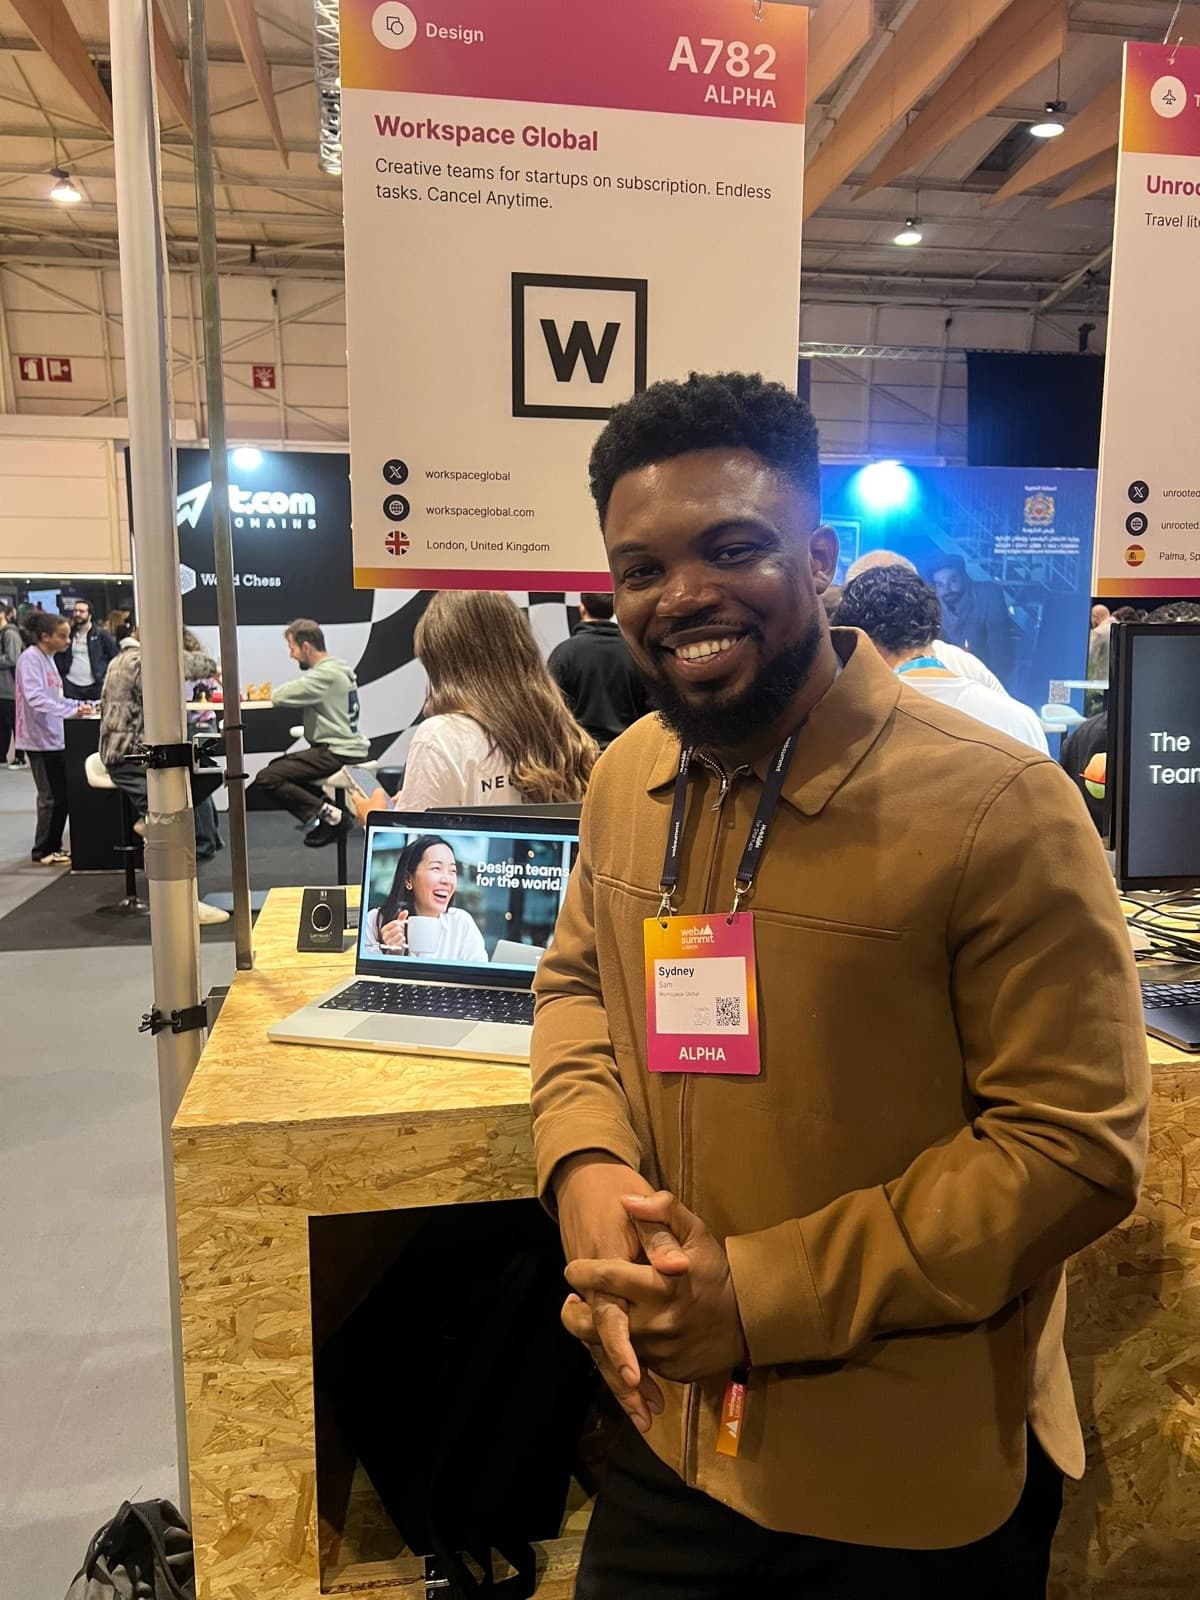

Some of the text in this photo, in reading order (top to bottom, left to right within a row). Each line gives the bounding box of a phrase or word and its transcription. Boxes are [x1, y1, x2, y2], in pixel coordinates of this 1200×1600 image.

[425, 22, 485, 43] Design
[668, 36, 777, 81] A782
[703, 84, 777, 109] ALPHA
[374, 114, 599, 151] Workspace Global
[375, 158, 772, 200] Creative teams for startups on subscription. Endless
[375, 184, 553, 210] tasks. Cancel Anytime.
[1144, 212, 1200, 229] Travel lit
[425, 470, 511, 483] workspaceglobal
[426, 506, 535, 519] workspaceglobal.com
[426, 540, 550, 554] London, United Kingdom
[1159, 551, 1187, 562] Palma,
[242, 574, 281, 587] Chess
[1150, 731, 1191, 752] The
[477, 861, 570, 878] Design teams
[476, 873, 495, 887] for
[497, 875, 520, 889] the
[681, 925, 699, 936] web
[681, 935, 715, 945] summit
[658, 966, 695, 978] Sydney
[659, 981, 673, 989] Sam
[679, 1046, 726, 1062] ALPHA
